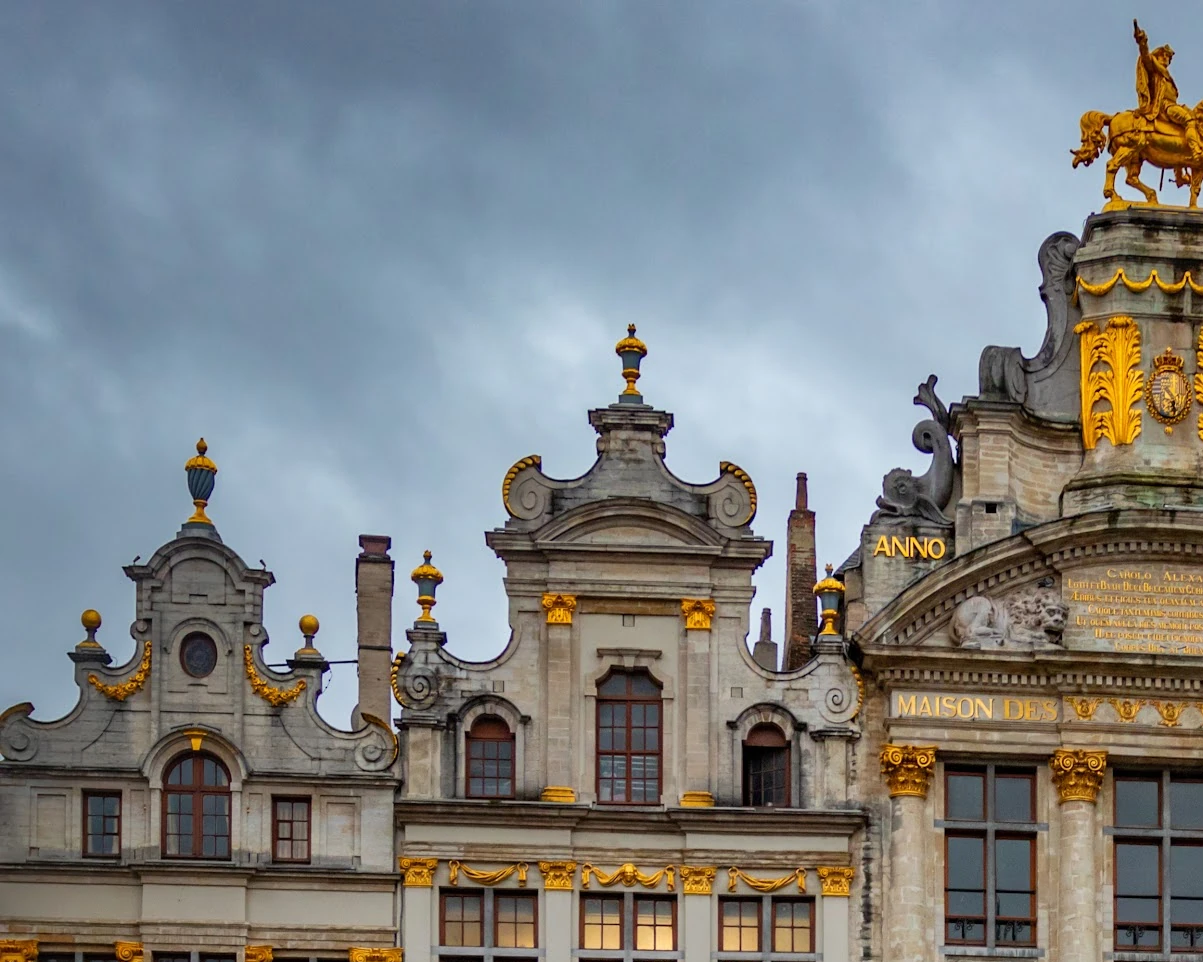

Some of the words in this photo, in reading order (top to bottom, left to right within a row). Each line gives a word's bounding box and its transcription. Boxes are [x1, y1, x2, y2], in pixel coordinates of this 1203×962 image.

[873, 535, 946, 559] ANNO
[1107, 568, 1152, 579] CAROLO
[898, 694, 994, 719] MAISON
[1003, 698, 1059, 721] DES
